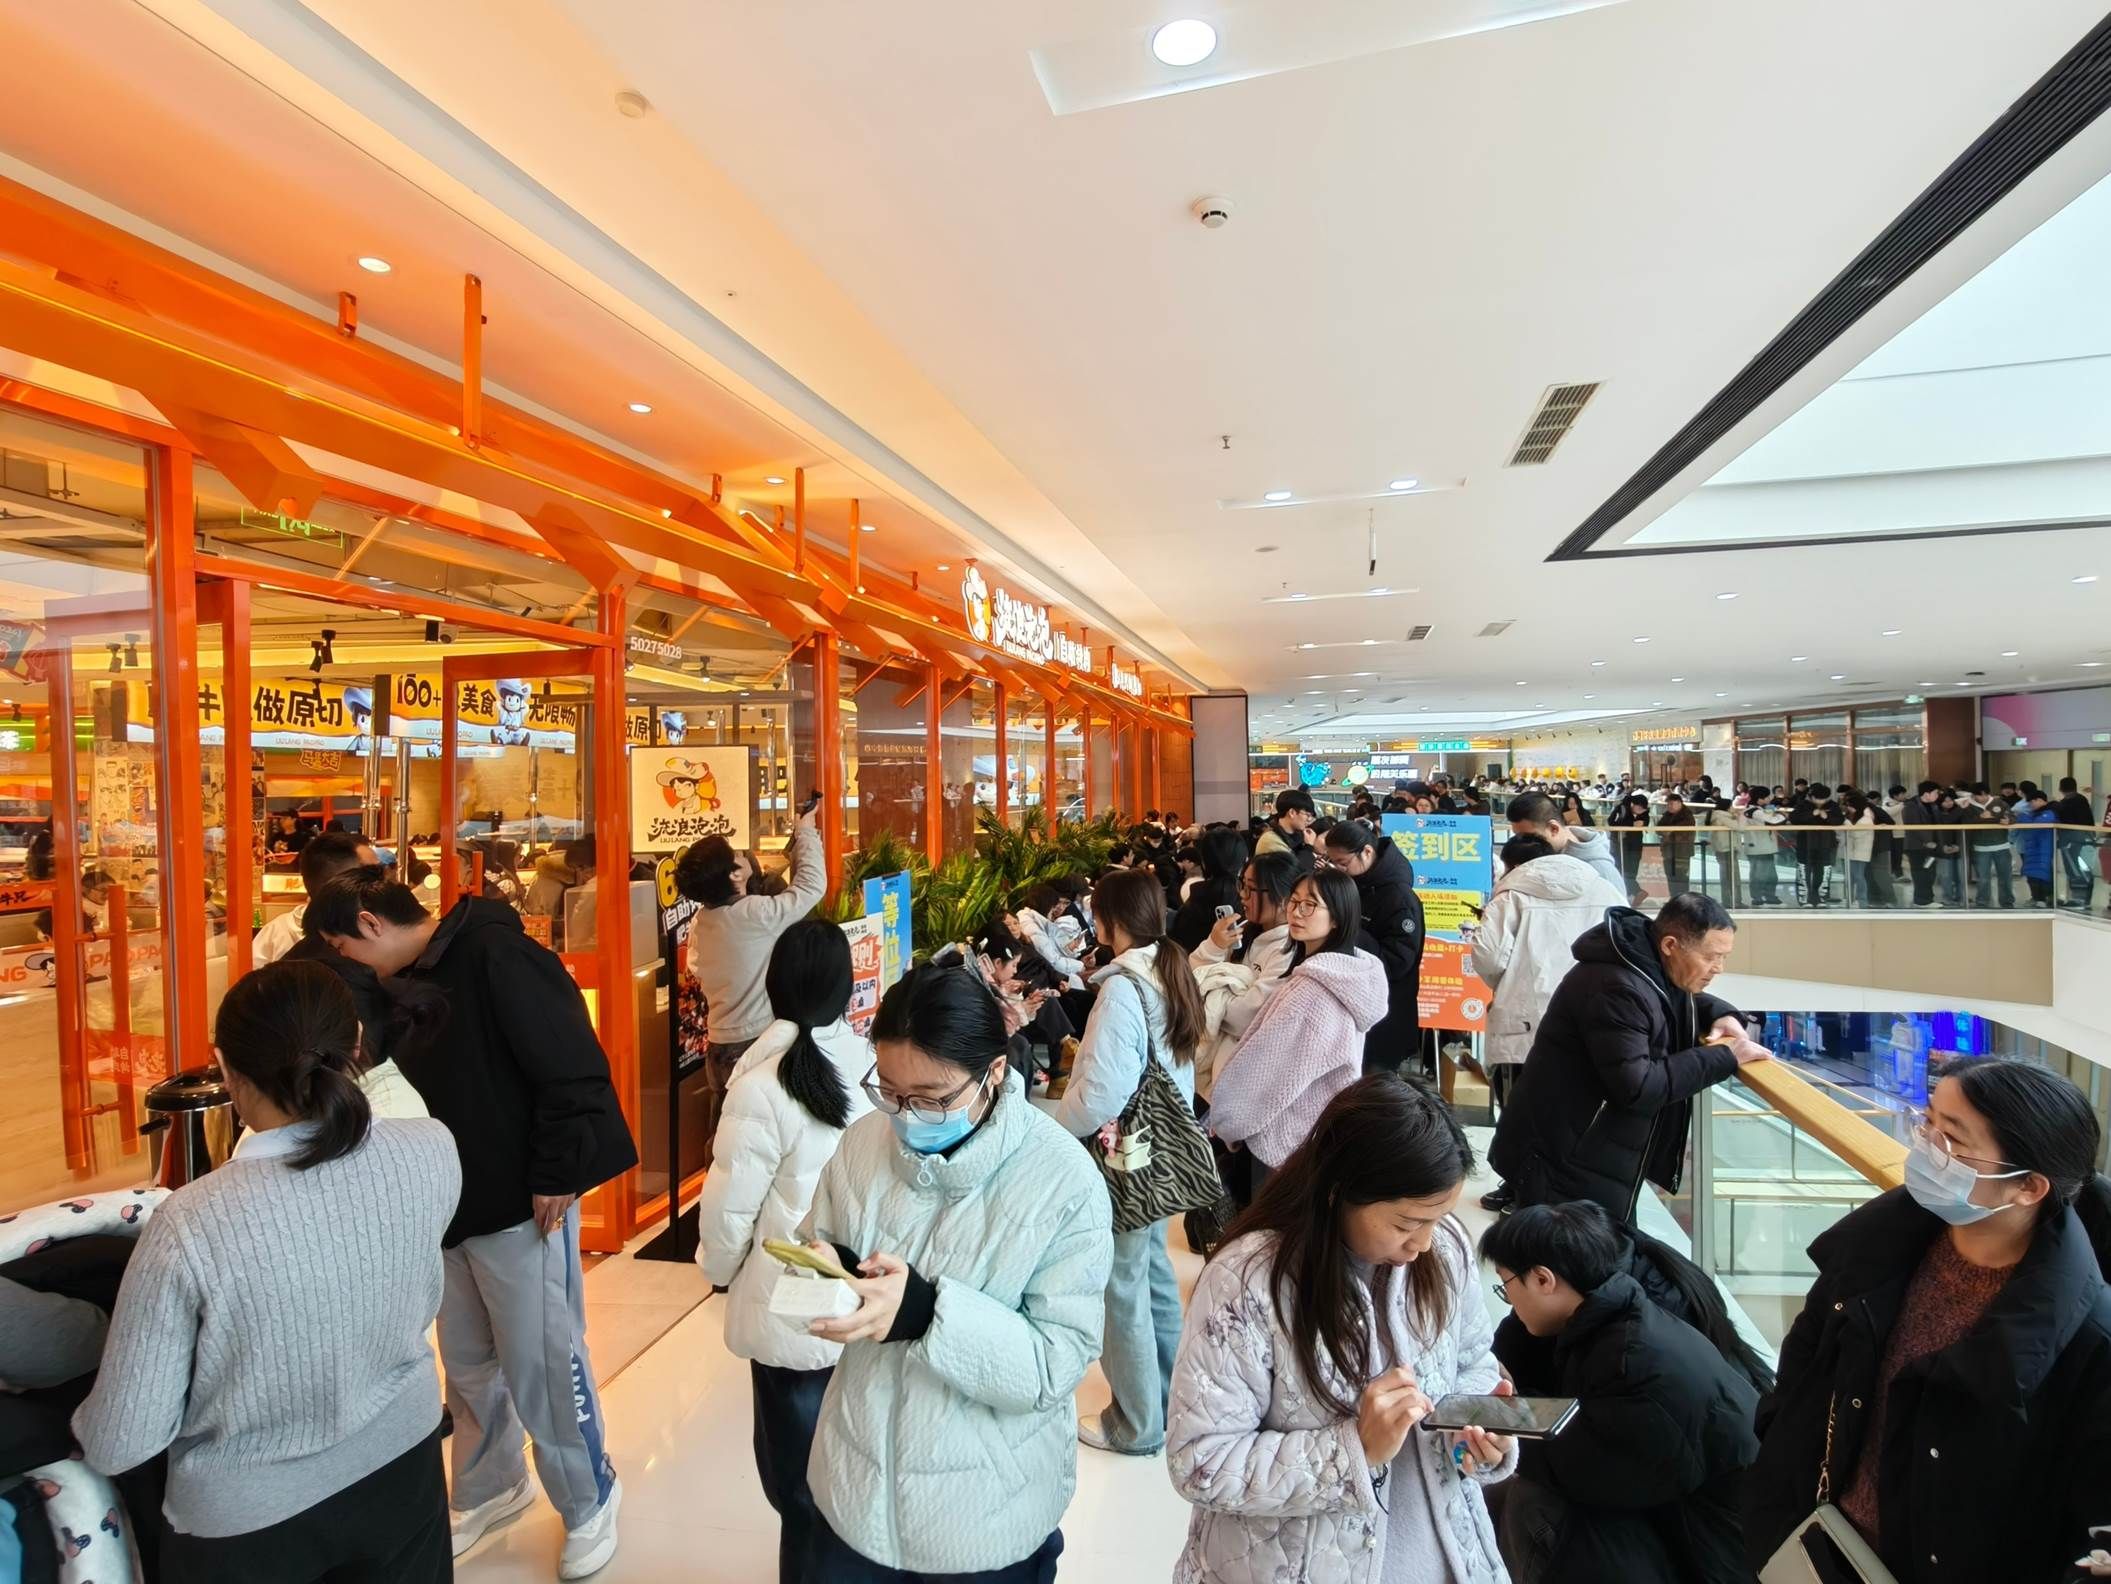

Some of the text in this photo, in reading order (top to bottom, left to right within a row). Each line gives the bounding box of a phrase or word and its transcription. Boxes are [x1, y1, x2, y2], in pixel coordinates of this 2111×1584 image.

[630, 637, 682, 659] 50275028
[648, 815, 737, 842] 流浪泡泡
[1392, 831, 1480, 861] 签到区
